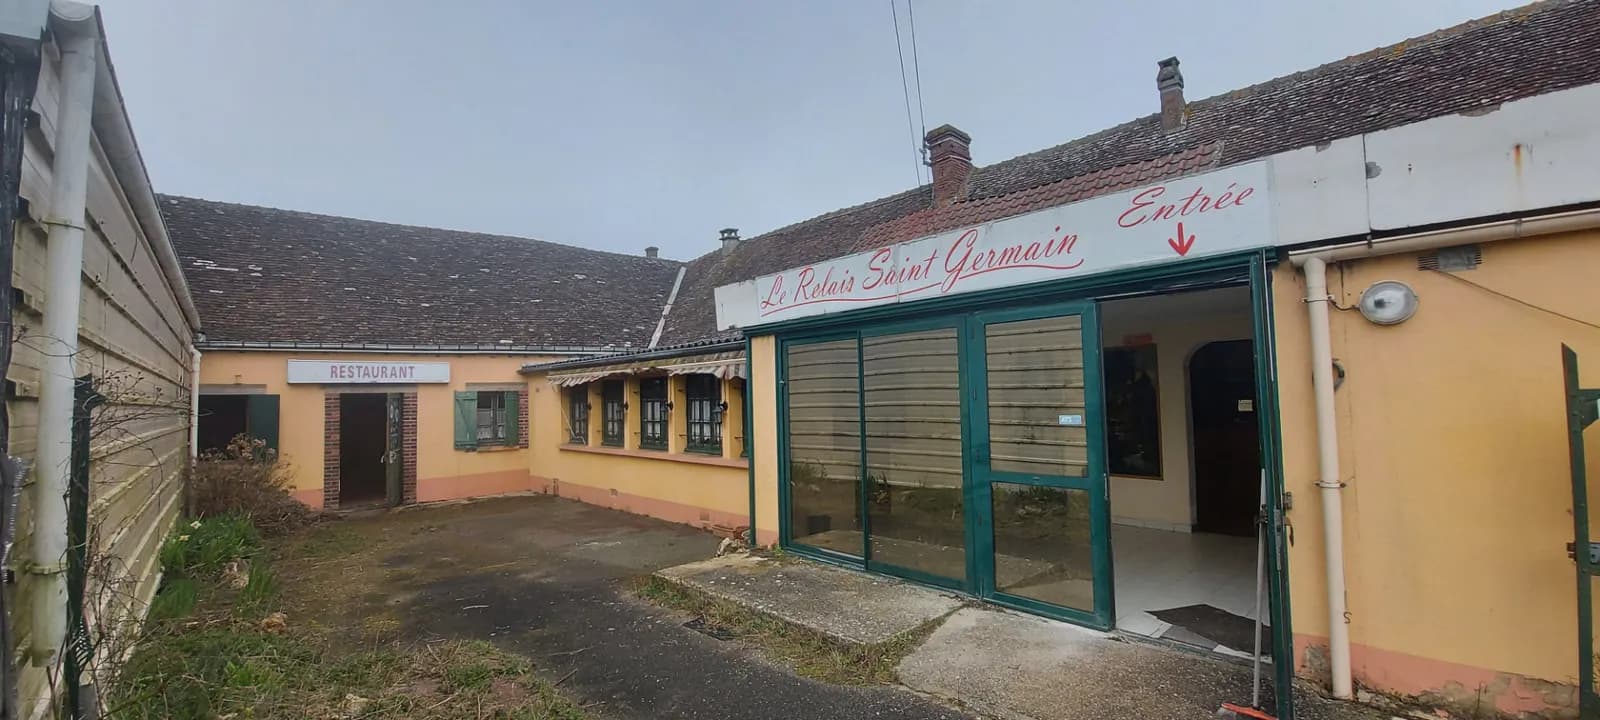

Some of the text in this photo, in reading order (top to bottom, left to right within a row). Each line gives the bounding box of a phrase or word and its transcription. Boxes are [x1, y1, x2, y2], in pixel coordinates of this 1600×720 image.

[1118, 182, 1254, 227] Entrée
[761, 226, 1079, 309] Le Relais Saint Germain
[330, 365, 415, 379] RESTAURANT
